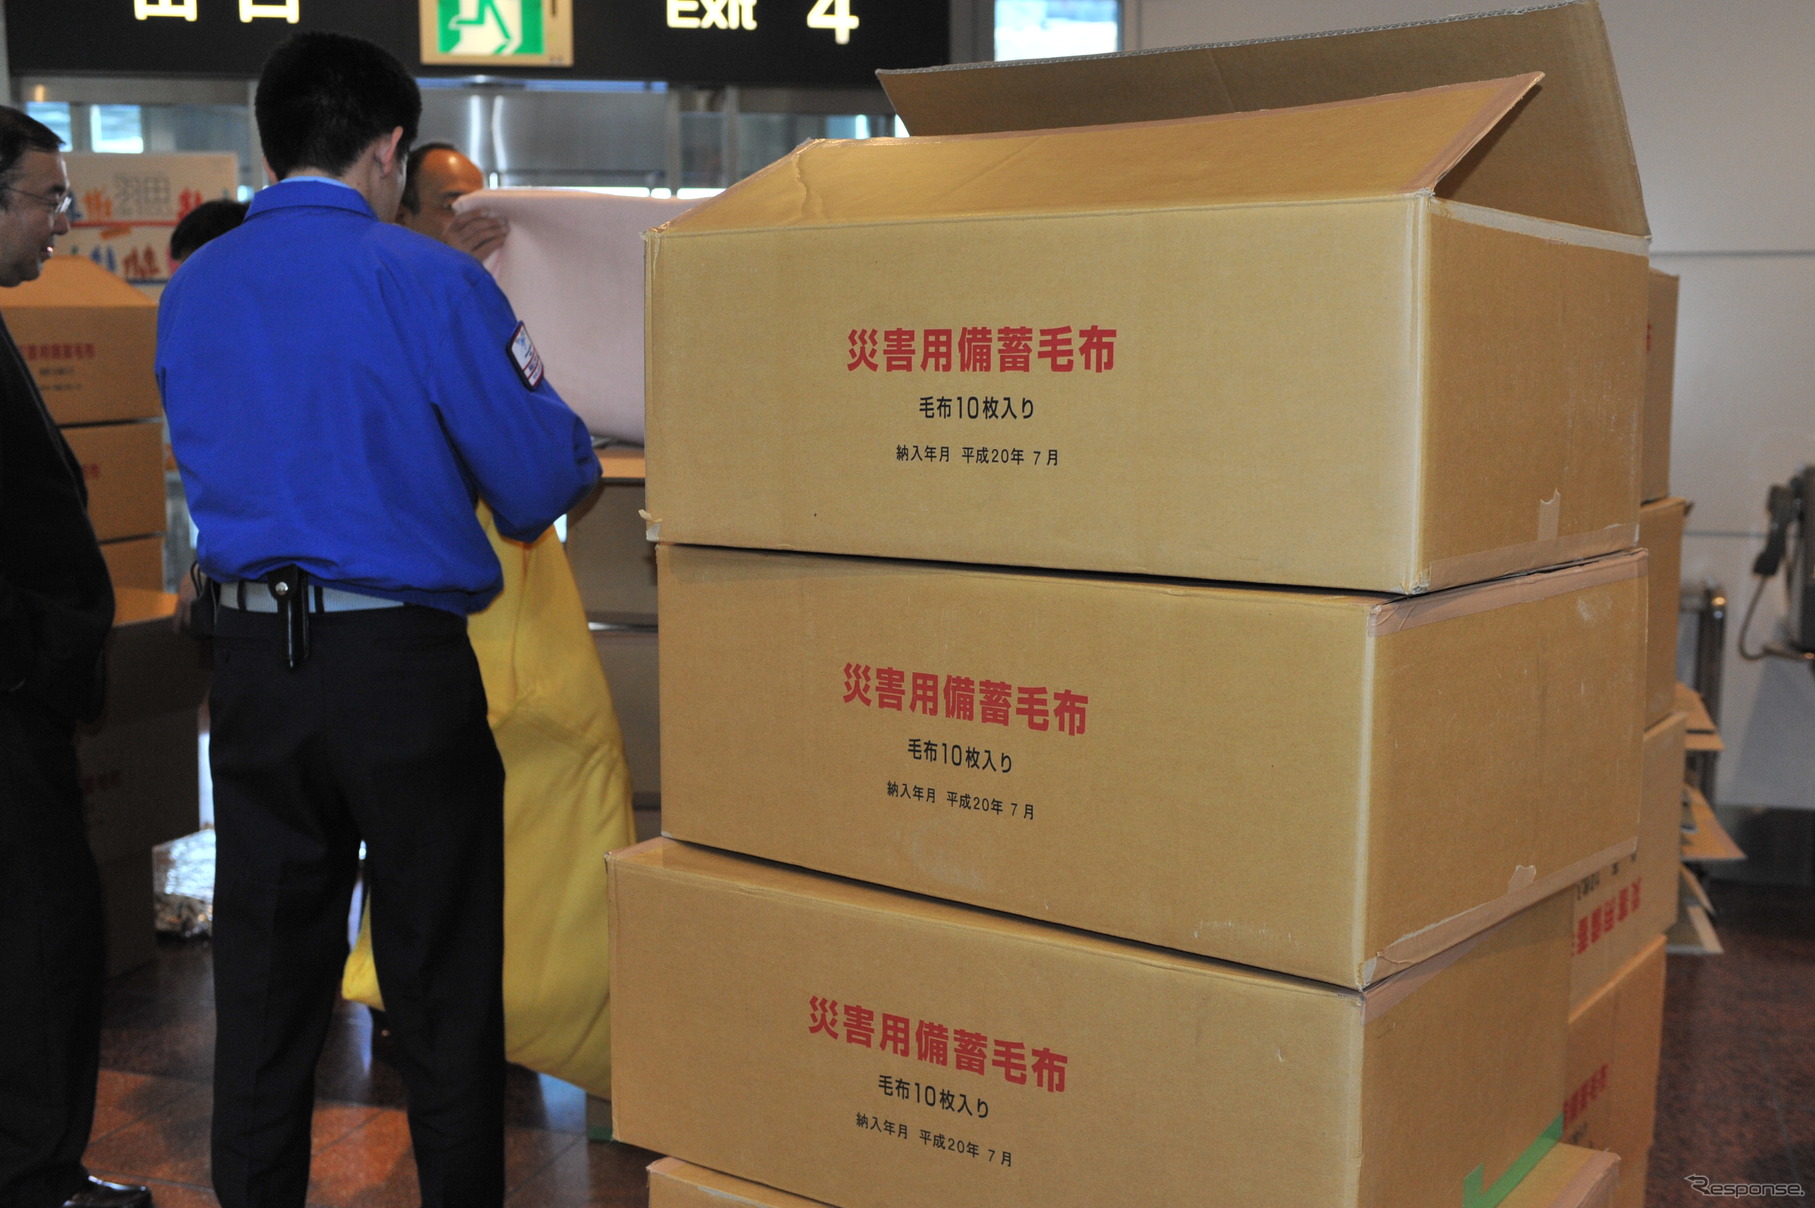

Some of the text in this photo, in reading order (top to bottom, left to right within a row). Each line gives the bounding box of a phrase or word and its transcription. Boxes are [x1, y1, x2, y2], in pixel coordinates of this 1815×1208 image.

[666, 0, 860, 45] Exit 4
[847, 325, 1117, 373] 災害用備蓄毛布
[919, 396, 1034, 419] 毛布10枚入り
[896, 444, 950, 463] 納入年月
[843, 662, 1089, 737] 災害用備蓄毛布
[907, 738, 1012, 774] 毛布10枚入り
[887, 780, 936, 804] 納入年月
[808, 995, 1068, 1093] 災害用備蓄毛布
[878, 1074, 989, 1119] 毛布10枚入り
[856, 1111, 908, 1140] 納入年月
